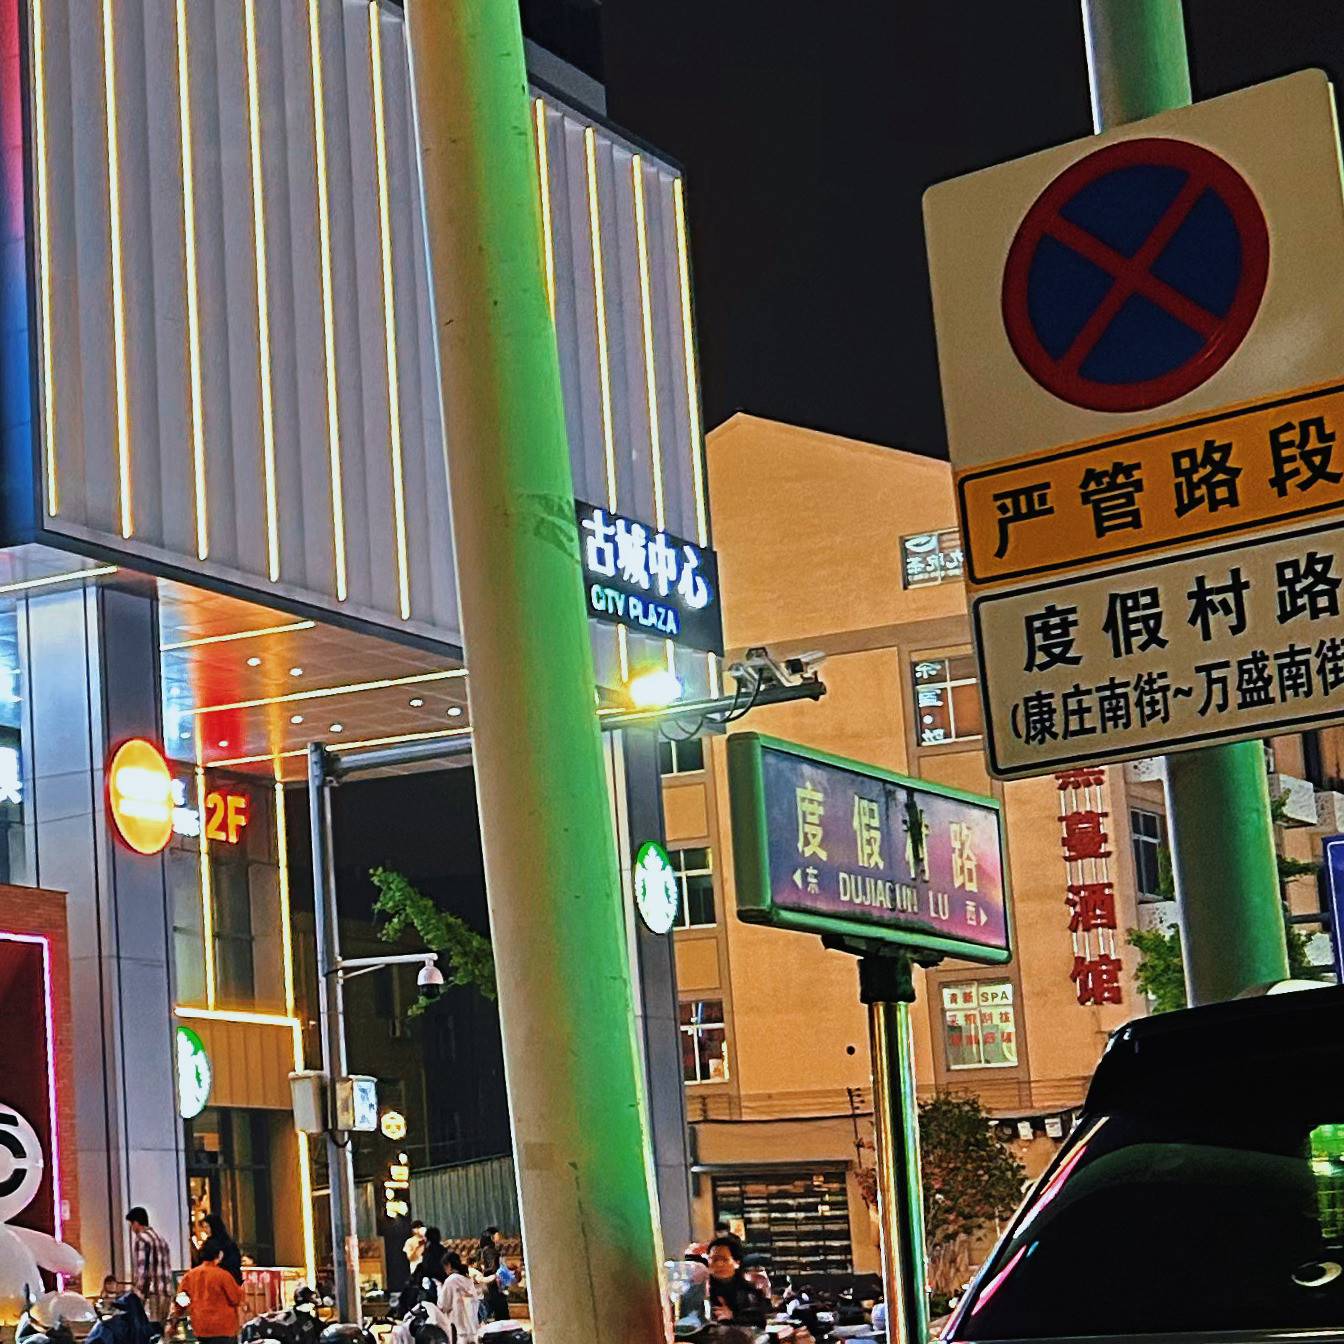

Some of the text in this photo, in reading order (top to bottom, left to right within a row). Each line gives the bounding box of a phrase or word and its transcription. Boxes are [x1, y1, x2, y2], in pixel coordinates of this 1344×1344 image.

[992, 416, 1343, 560] 严管路段
[582, 509, 708, 609] 古城中心
[628, 596, 678, 635] PLAZA
[1023, 551, 1343, 674] 度假村路
[206, 792, 247, 844] 2F
[795, 780, 978, 893] 度假村路
[839, 872, 949, 921] DUJIACUN LU
[980, 990, 1009, 1003] SPA
